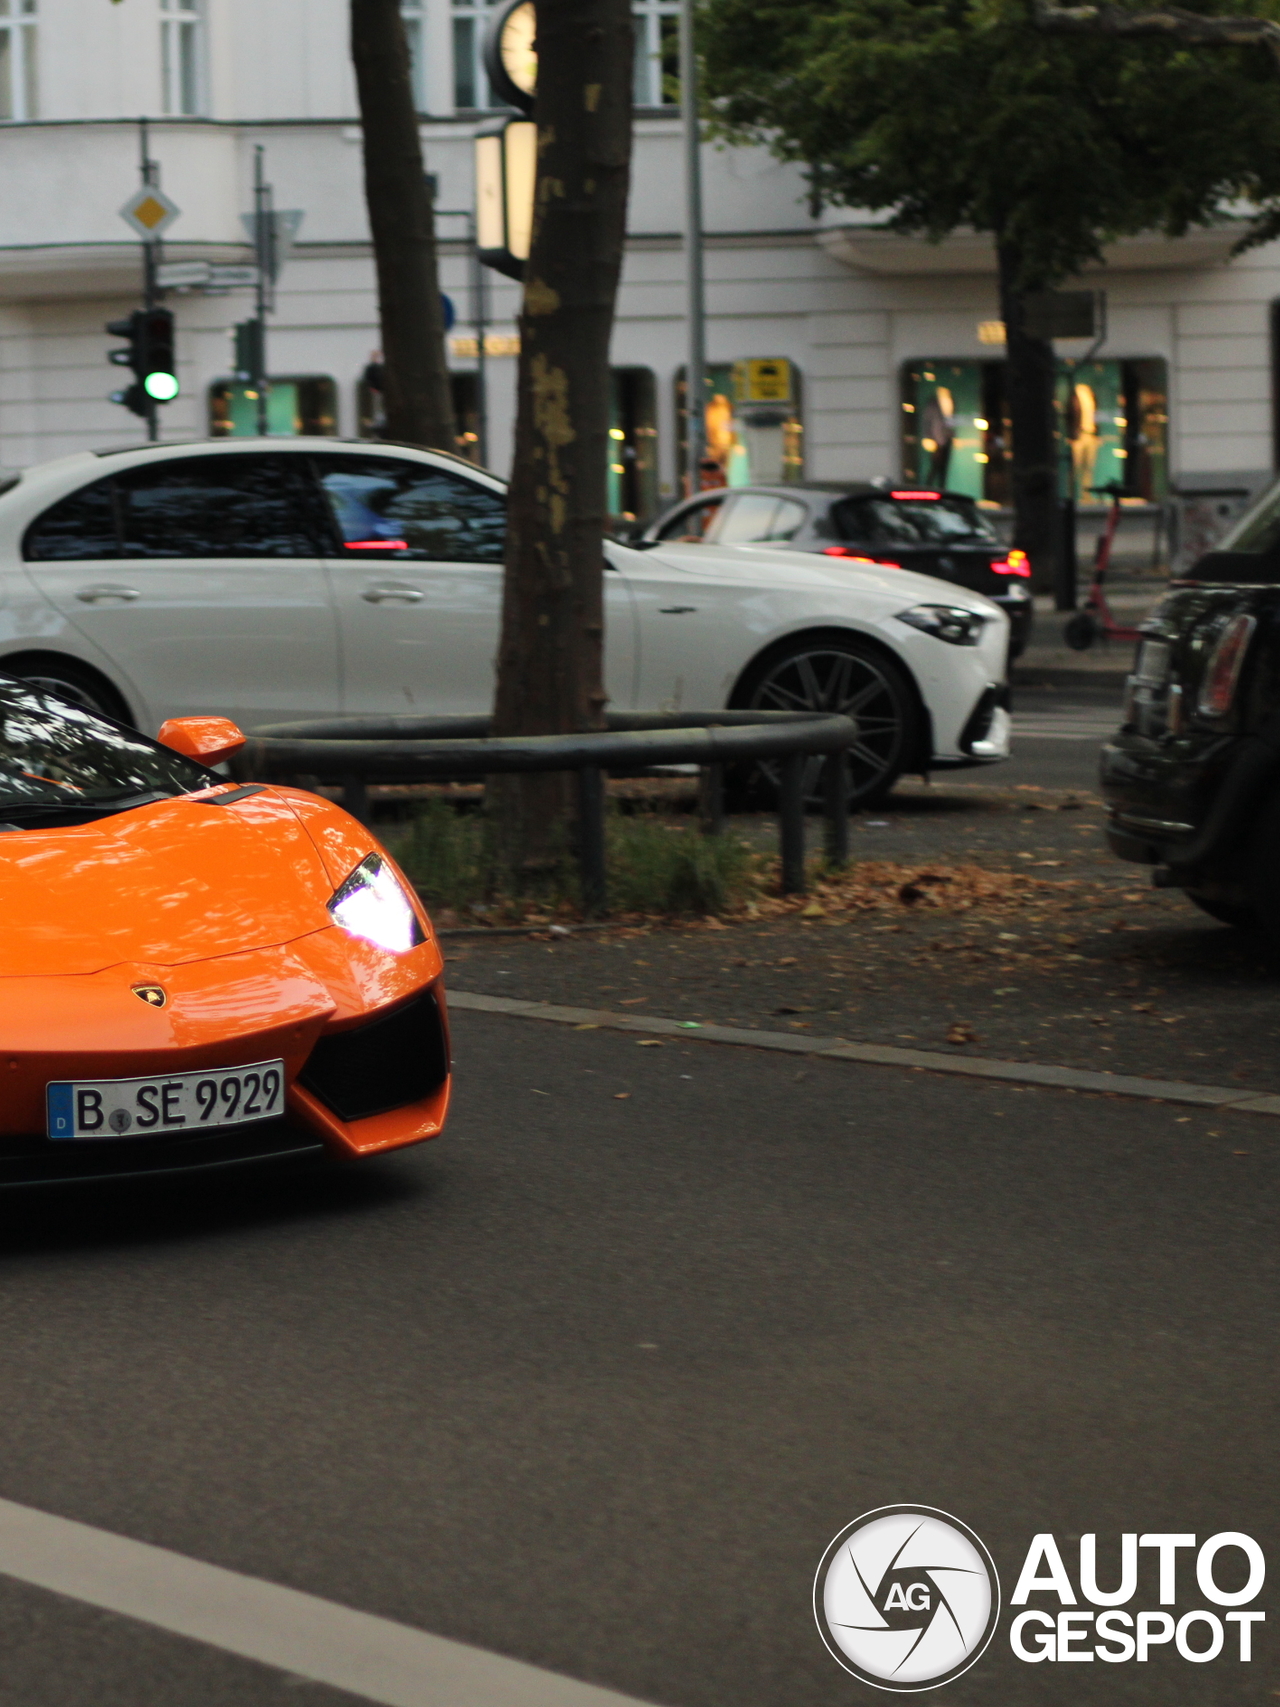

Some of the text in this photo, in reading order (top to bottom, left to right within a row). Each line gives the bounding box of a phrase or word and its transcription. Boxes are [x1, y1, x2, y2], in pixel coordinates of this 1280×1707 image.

[77, 1068, 280, 1131] B SE 9929
[56, 1117, 66, 1129] D
